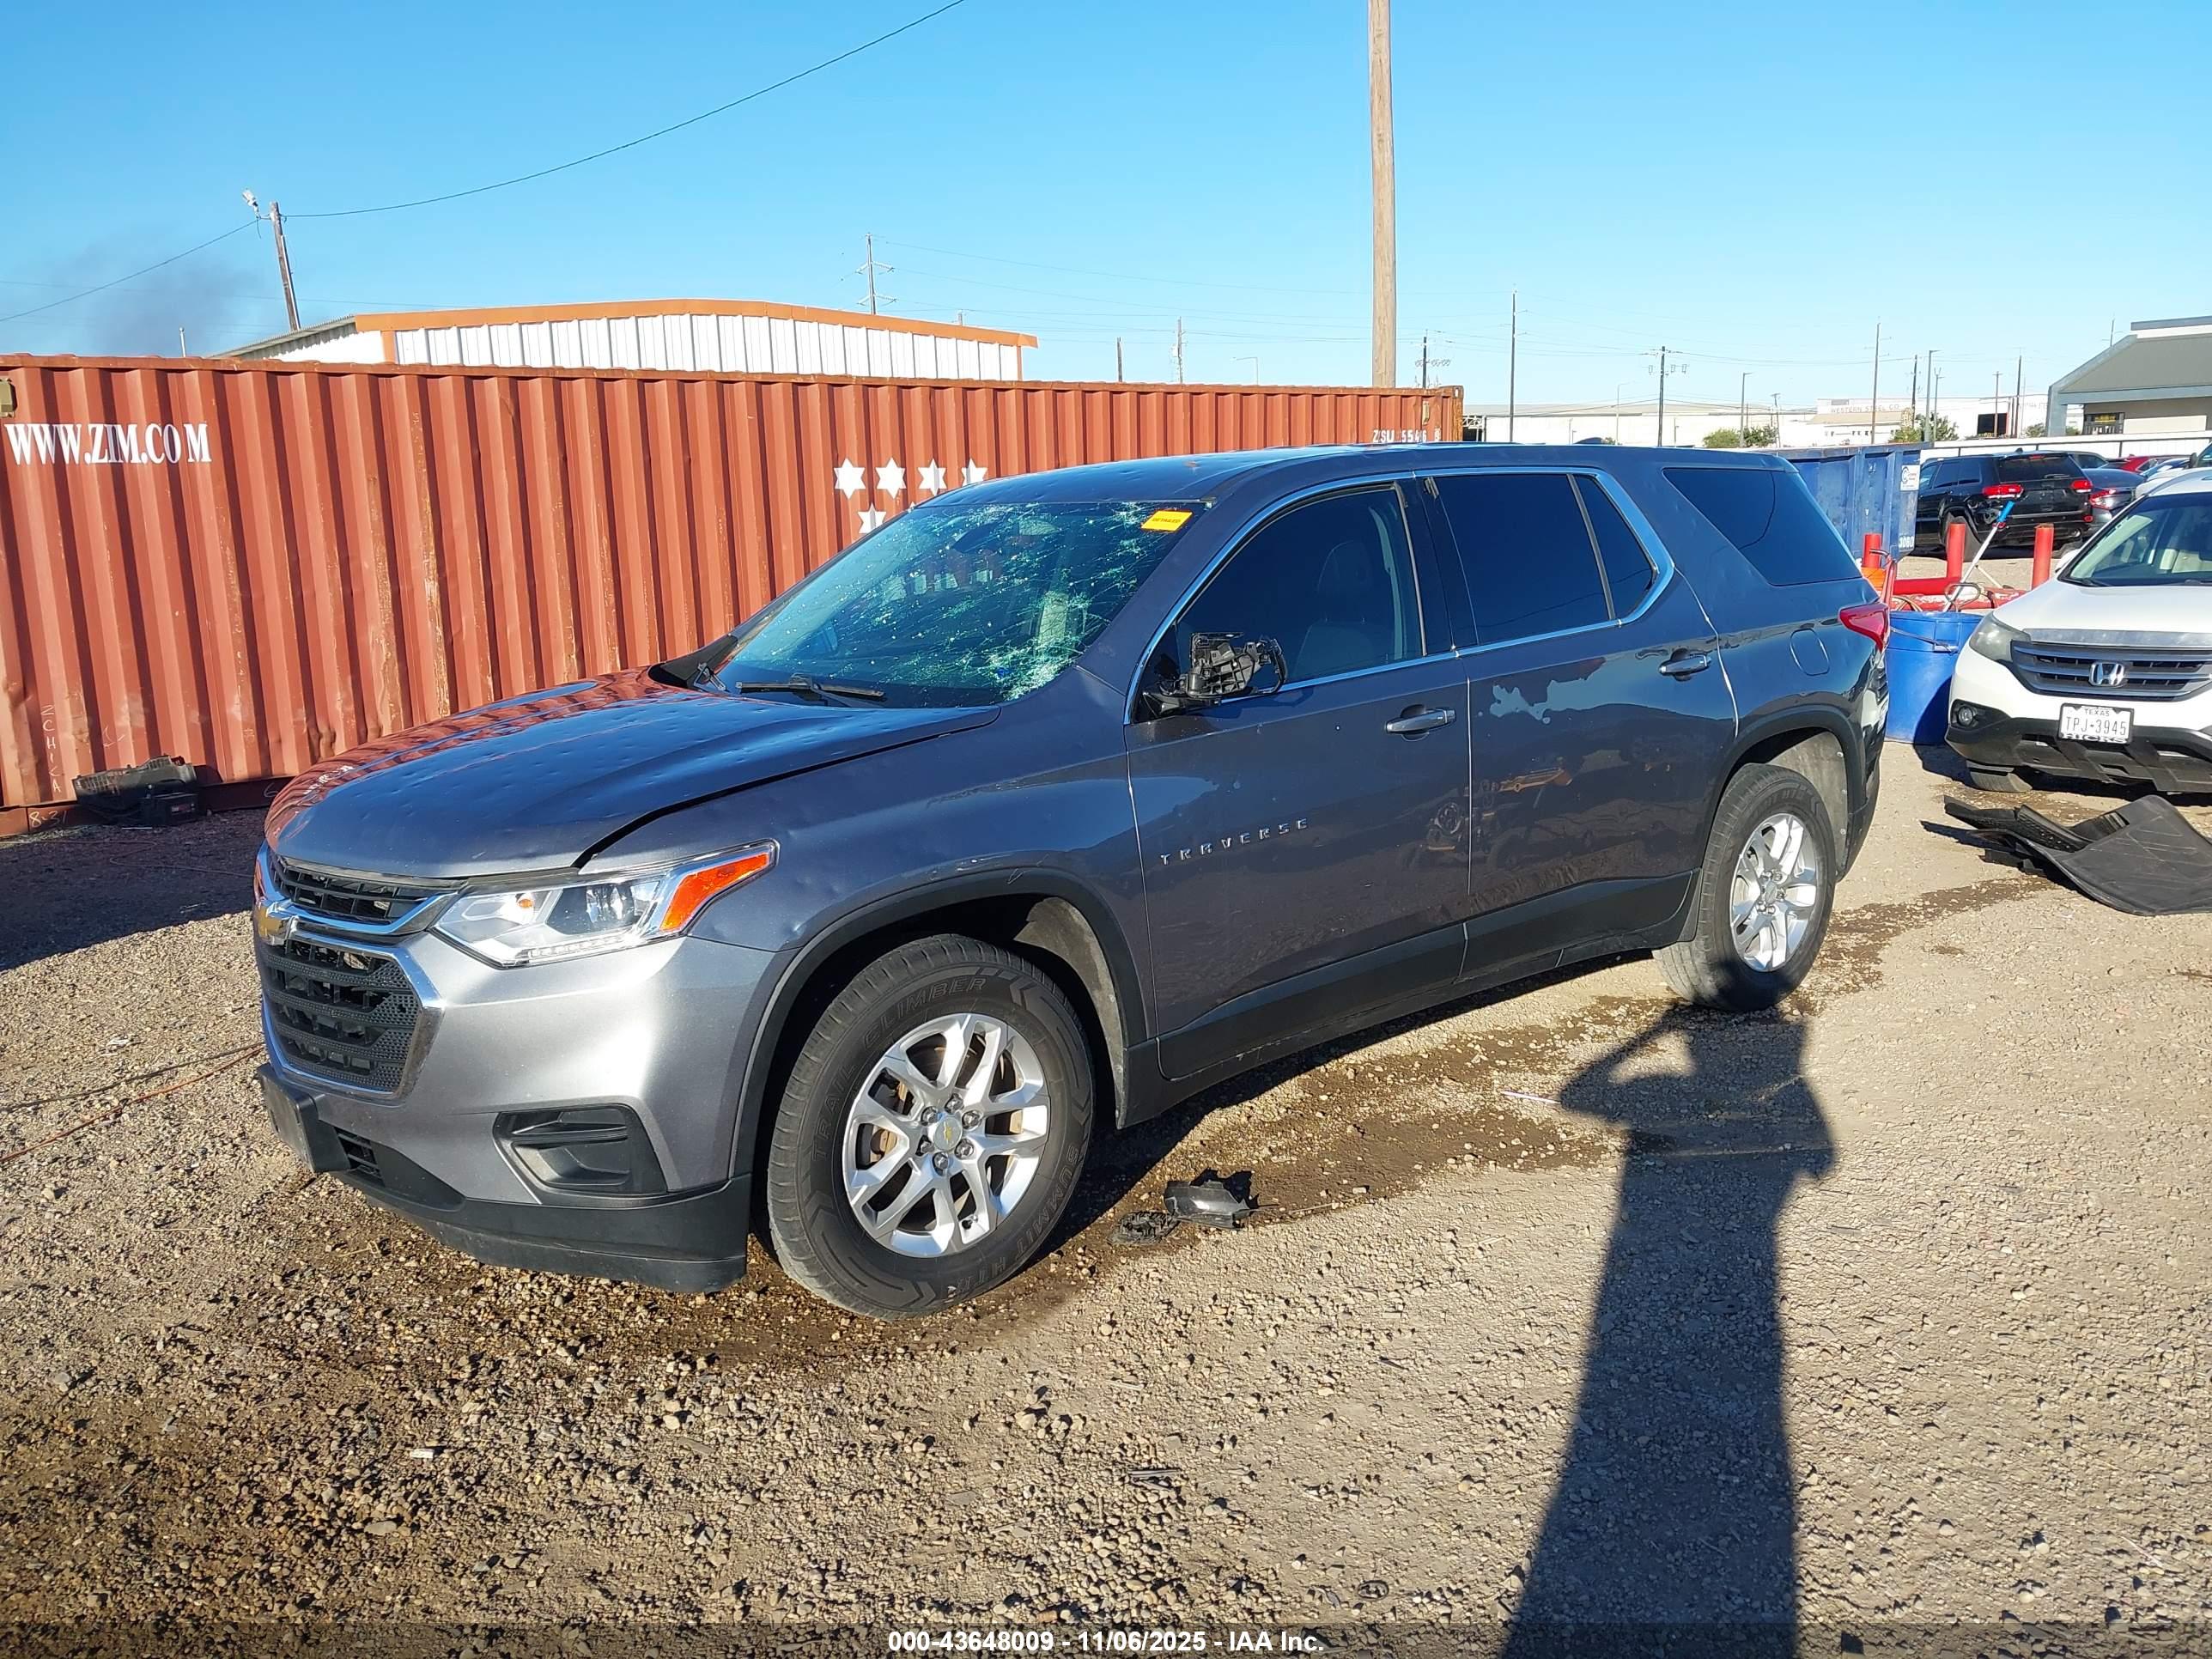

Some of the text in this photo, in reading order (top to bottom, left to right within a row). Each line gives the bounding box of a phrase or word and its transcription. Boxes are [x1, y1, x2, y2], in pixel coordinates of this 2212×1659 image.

[4, 423, 212, 465] WWW.ZIM.COM
[1160, 818, 1307, 866] TRAVERSE
[862, 976, 988, 1049] CLIMBER
[811, 1064, 857, 1161] TRAIL
[1015, 1143, 1080, 1261] SUMMIT
